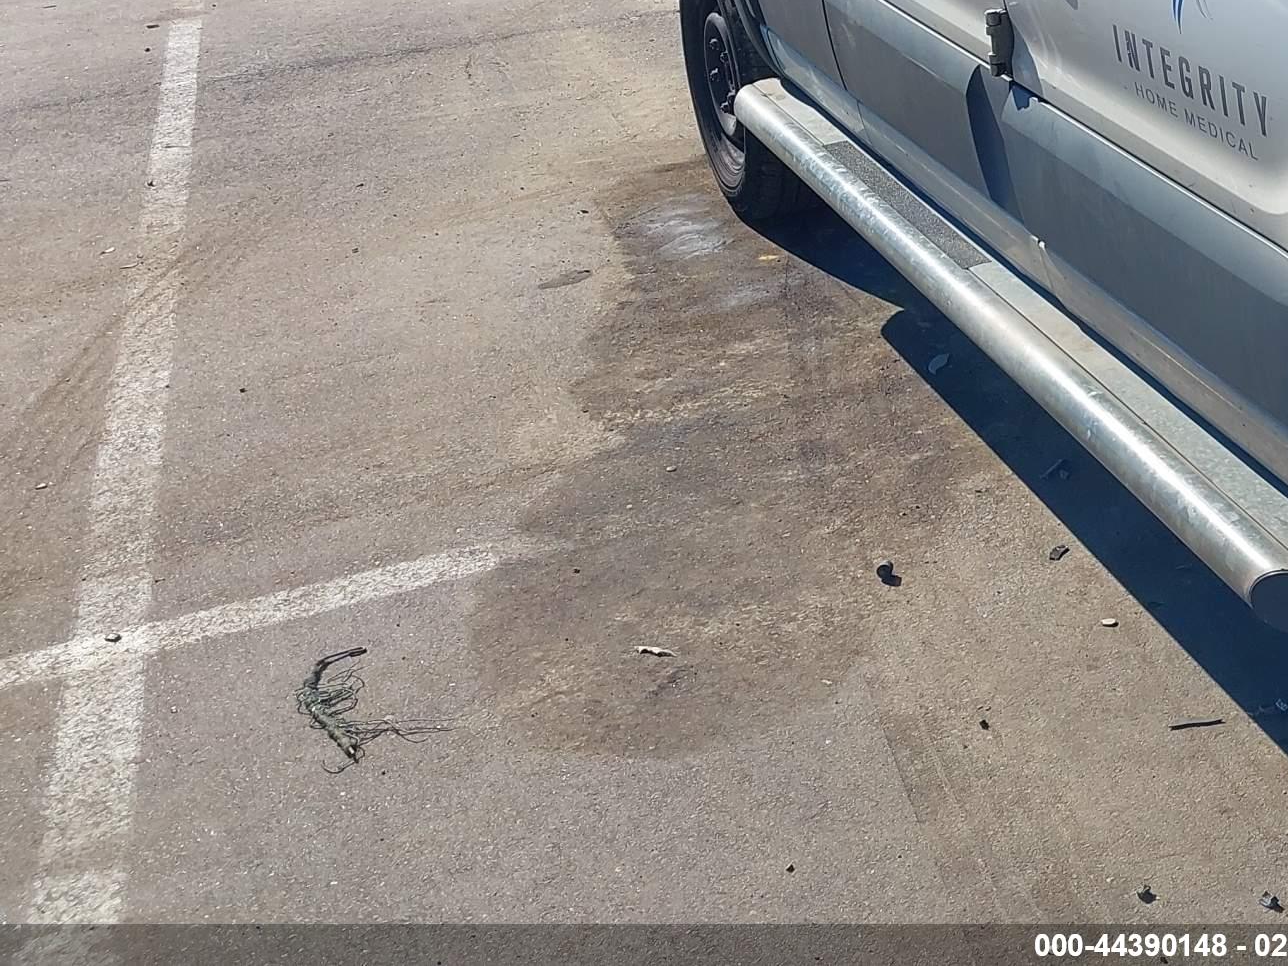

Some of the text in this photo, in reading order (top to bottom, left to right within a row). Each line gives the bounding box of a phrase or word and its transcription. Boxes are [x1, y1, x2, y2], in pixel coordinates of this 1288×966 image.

[1112, 24, 1270, 137] INTEGRITY
[1134, 81, 1260, 161] HOME MEDICAL
